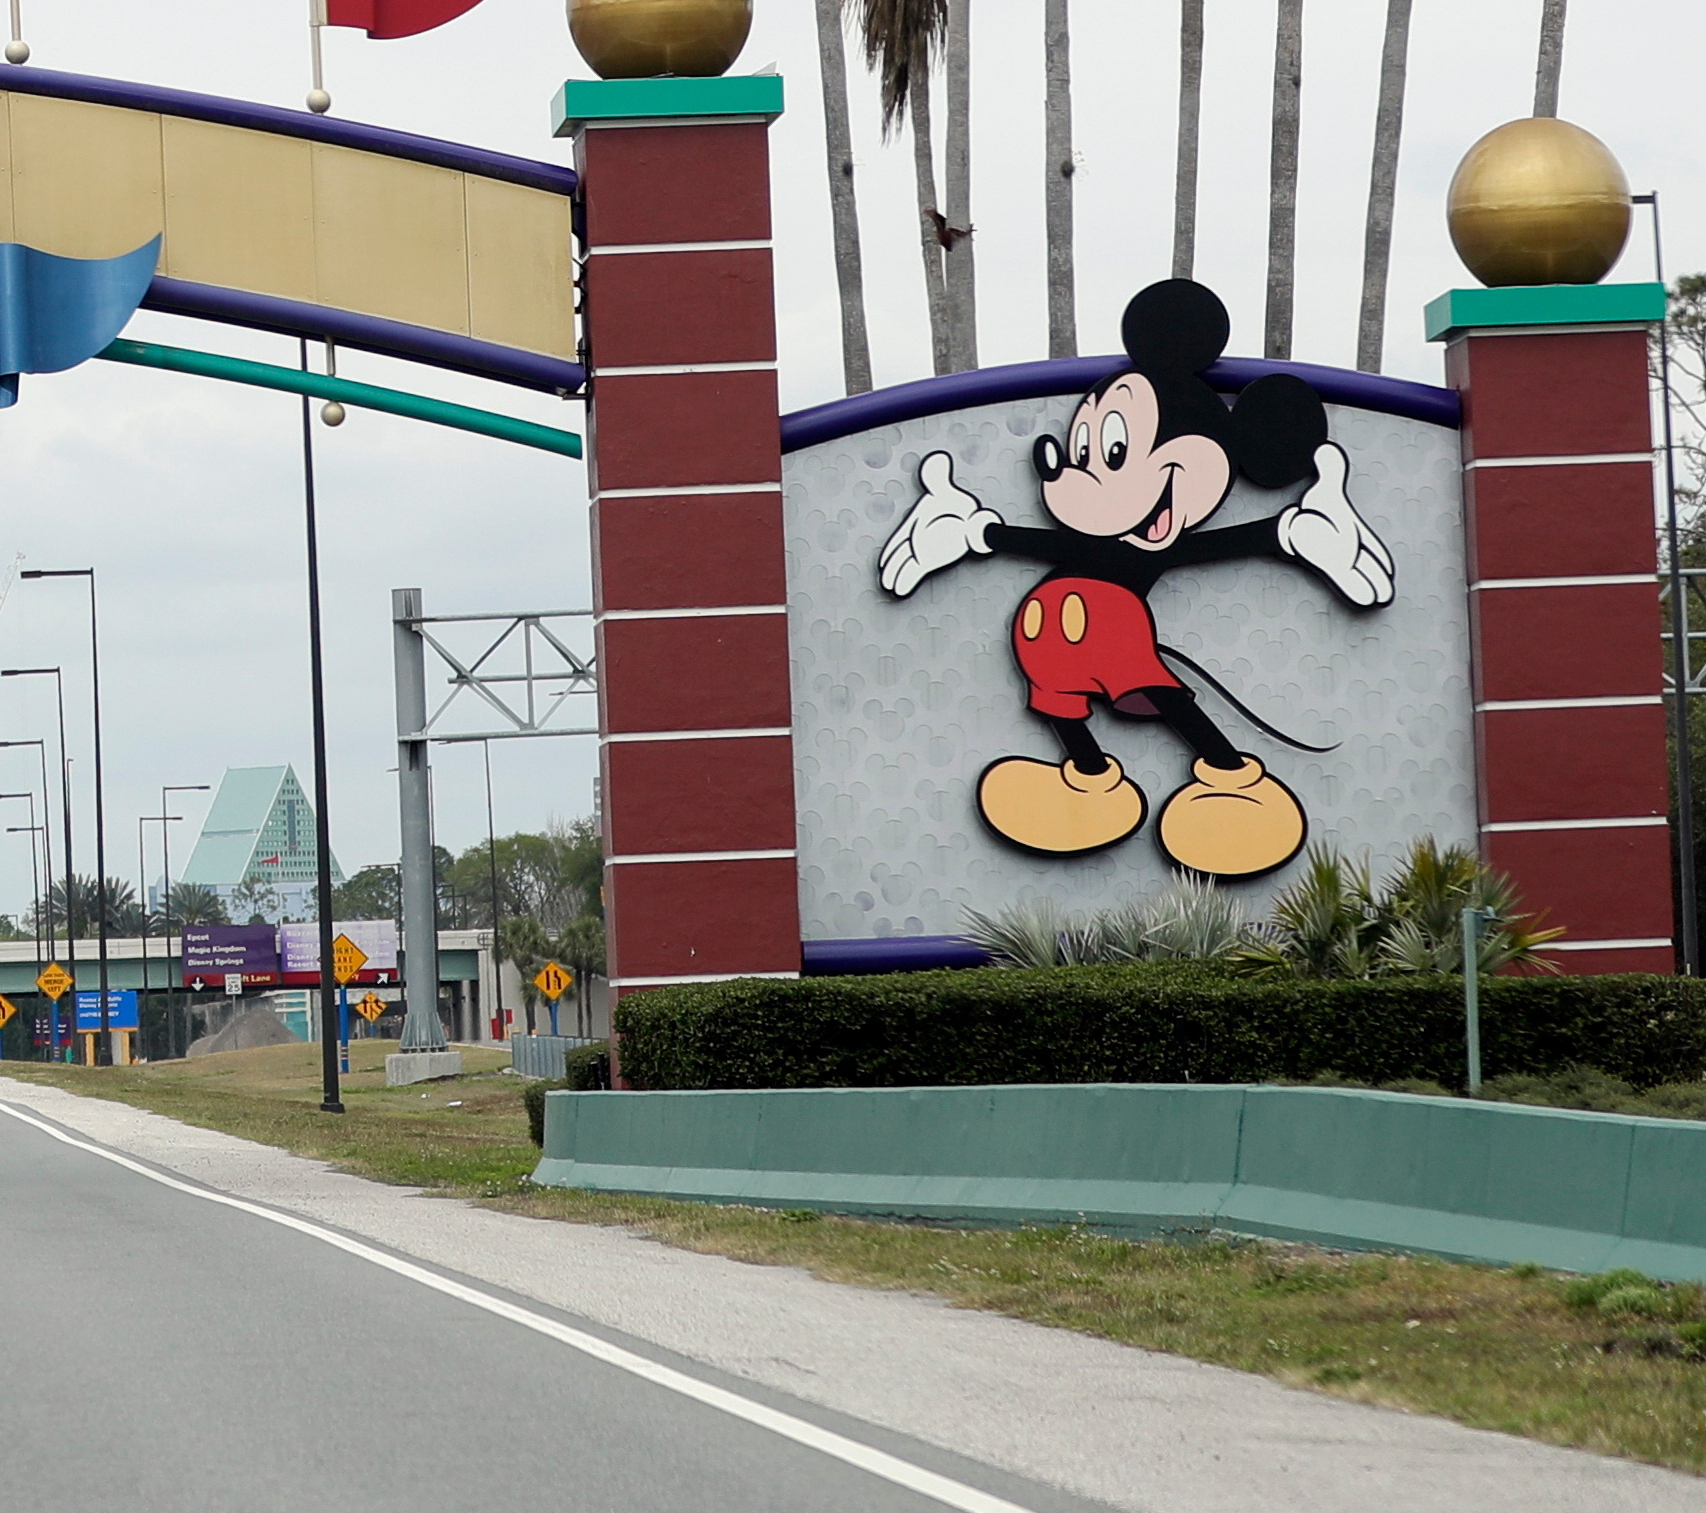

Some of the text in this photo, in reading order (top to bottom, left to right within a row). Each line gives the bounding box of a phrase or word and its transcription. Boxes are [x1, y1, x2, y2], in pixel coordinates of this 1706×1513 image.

[186, 933, 209, 942] Epcot
[187, 945, 247, 954] Magic Kingdom
[214, 958, 244, 966] Springs
[336, 965, 353, 973] NDS
[251, 975, 271, 983] Lane
[227, 984, 240, 993] 25
